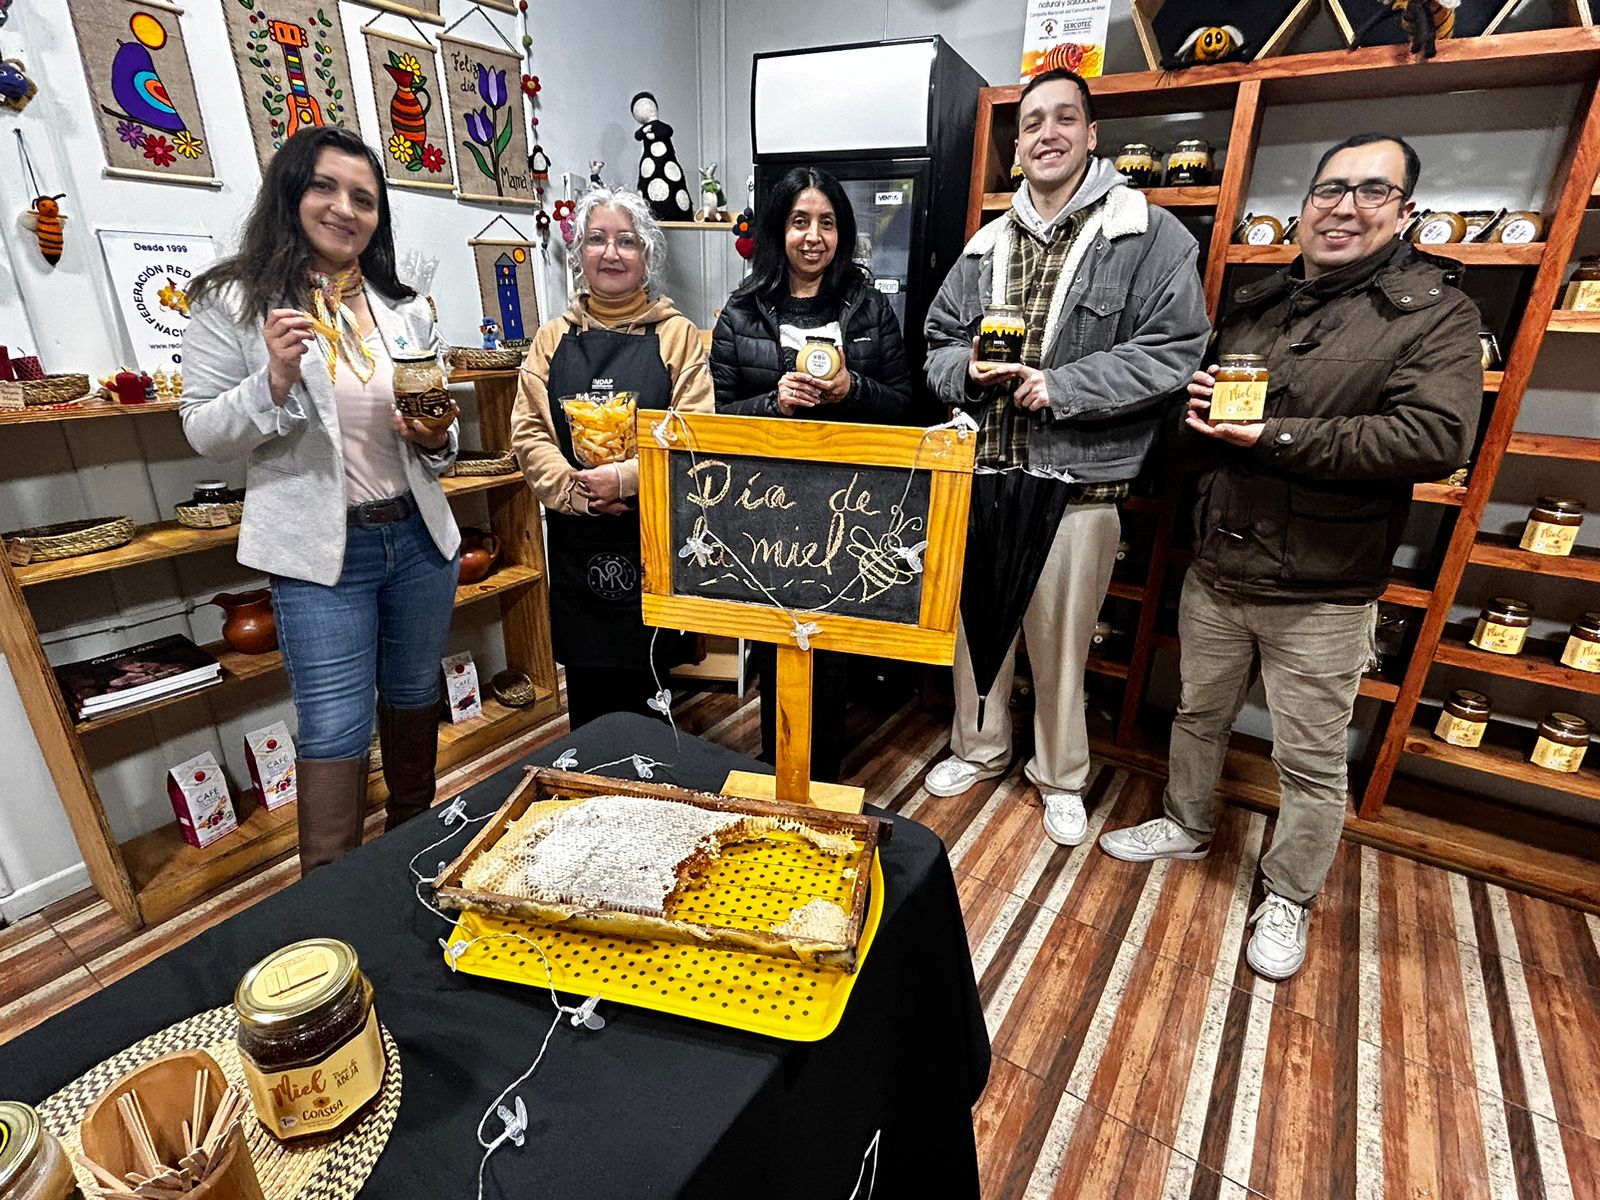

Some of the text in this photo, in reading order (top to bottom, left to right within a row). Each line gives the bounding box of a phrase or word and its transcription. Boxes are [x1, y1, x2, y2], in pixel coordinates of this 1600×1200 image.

[1063, 21, 1092, 30] SERCOTEC
[451, 51, 480, 79] Feliz
[133, 242, 188, 253] Desde 1999
[166, 264, 192, 279] RED
[1228, 383, 1254, 402] Miel
[686, 459, 881, 516] Día de
[742, 509, 847, 577] miel
[268, 1069, 326, 1107] Miel
[336, 1065, 359, 1089] ABEJA
